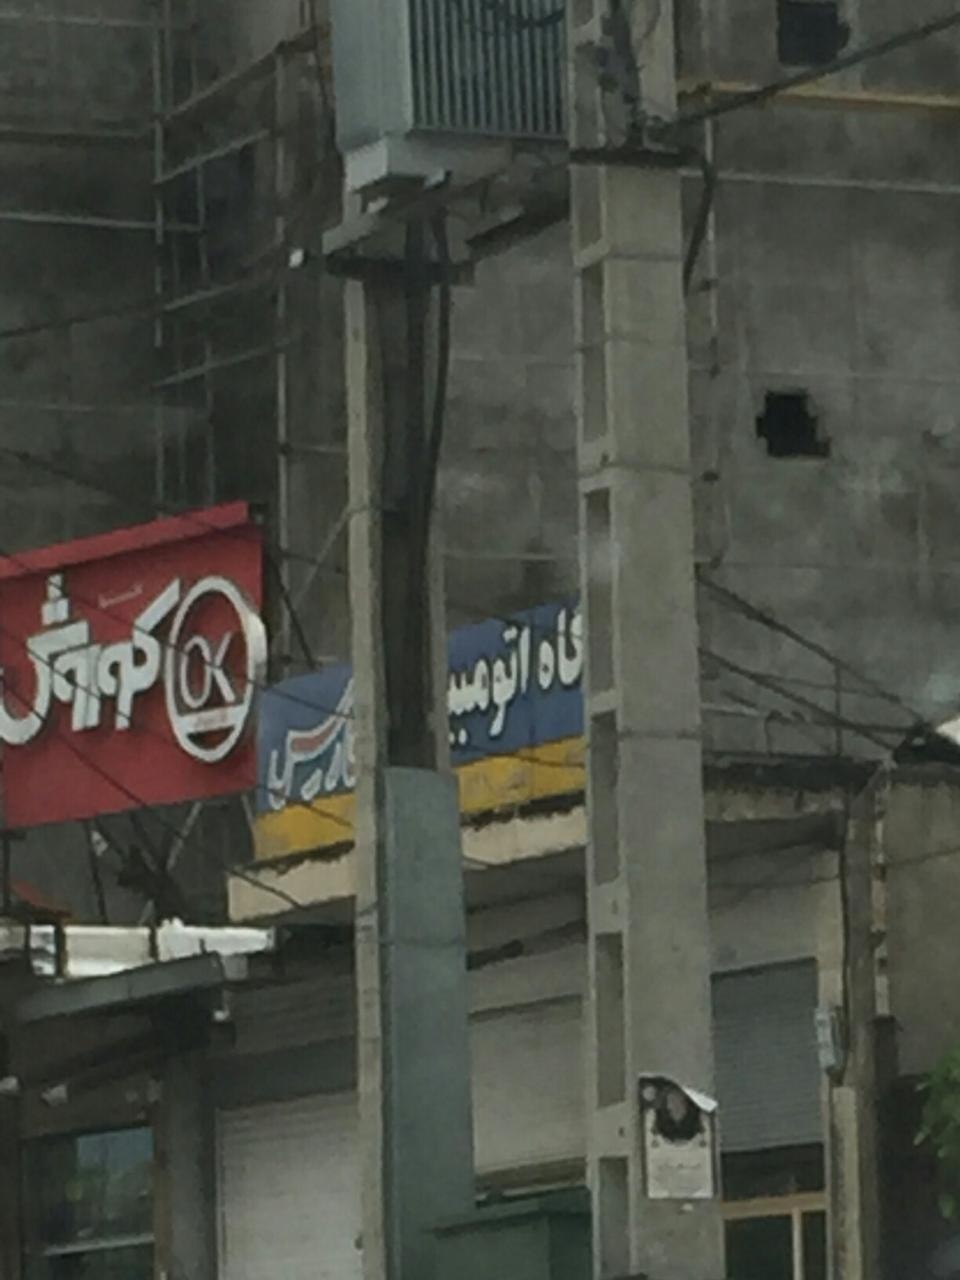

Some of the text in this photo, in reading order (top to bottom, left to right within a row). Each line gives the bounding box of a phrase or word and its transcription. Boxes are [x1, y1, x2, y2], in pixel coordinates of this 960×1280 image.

[0, 573, 181, 746] کوروش
[181, 632, 237, 709] OK
[448, 626, 531, 747] اتومبی
